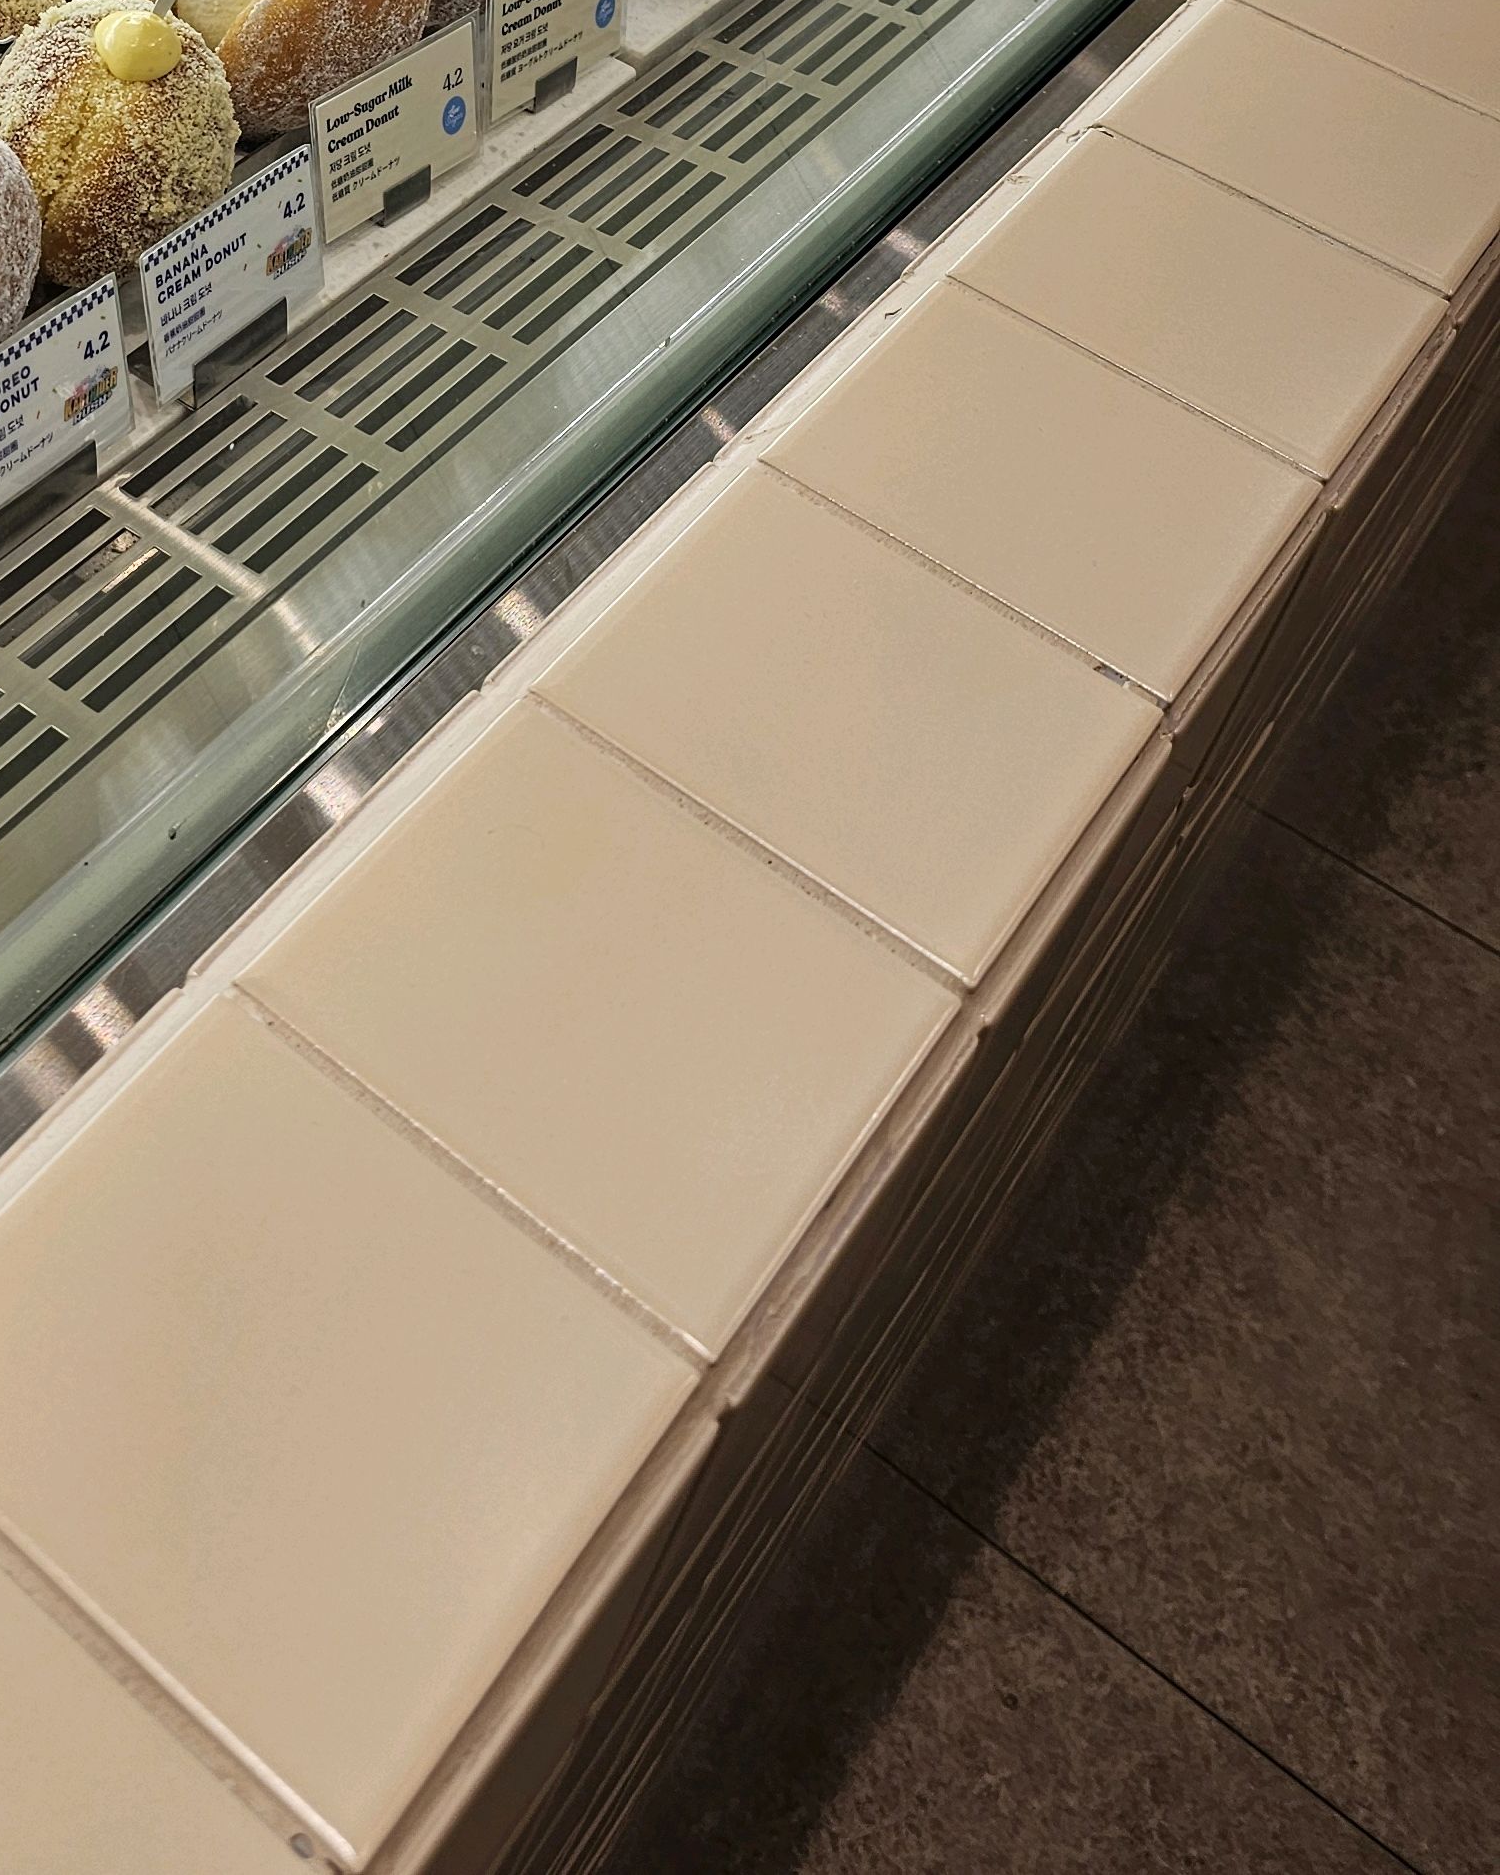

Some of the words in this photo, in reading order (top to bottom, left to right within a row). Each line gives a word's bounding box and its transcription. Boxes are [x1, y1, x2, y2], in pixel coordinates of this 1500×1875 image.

[501, 14, 532, 36] Cream
[443, 67, 463, 91] 4.2
[326, 90, 388, 133] Low-Sugar
[388, 74, 413, 98] Milk
[327, 126, 364, 153] Cream
[365, 105, 399, 133] Donut
[343, 149, 357, 166] 크림
[358, 141, 371, 157] 도넛
[283, 192, 305, 219] 4.2
[155, 244, 208, 288] BANANA
[157, 265, 201, 304] CREAM
[205, 232, 246, 272] DONUT
[161, 303, 182, 326] 바나나
[183, 292, 197, 311] 크림
[198, 281, 212, 300] 도넛
[84, 330, 110, 360] 4.2
[7, 414, 24, 435] 도넛
